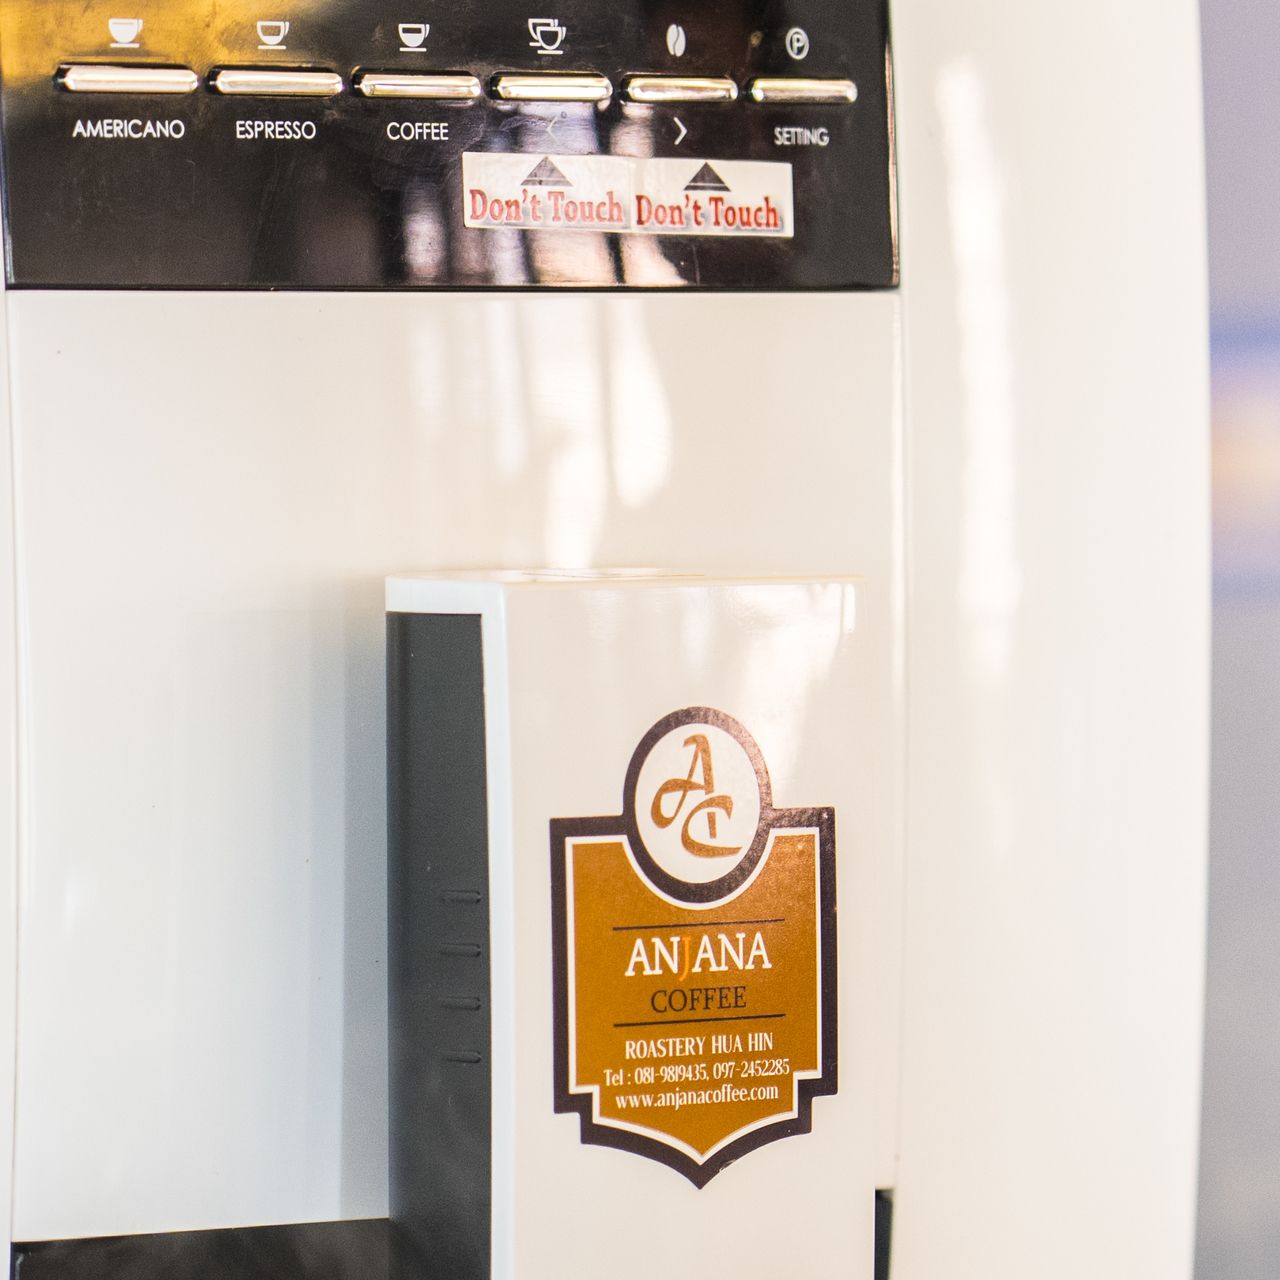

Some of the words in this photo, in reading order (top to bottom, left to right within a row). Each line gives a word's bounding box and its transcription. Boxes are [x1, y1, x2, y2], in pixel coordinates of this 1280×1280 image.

[72, 118, 185, 139] AMERICANO
[235, 120, 316, 140] ESPRESSO
[386, 121, 449, 141] COFFEE
[773, 126, 830, 146] SETTING
[469, 187, 542, 222] Don't
[547, 190, 624, 223] Touch
[635, 193, 703, 226] Don't
[708, 195, 780, 228] Touch
[624, 931, 773, 982] ANJANA
[651, 985, 747, 1013] COFFEE
[625, 1036, 706, 1060] ROASTERY
[711, 1033, 743, 1054] HUA
[748, 1032, 774, 1052] HIN
[713, 1058, 790, 1081] 097-2452285
[615, 1084, 780, 1111] www.anjanacoffee.com
